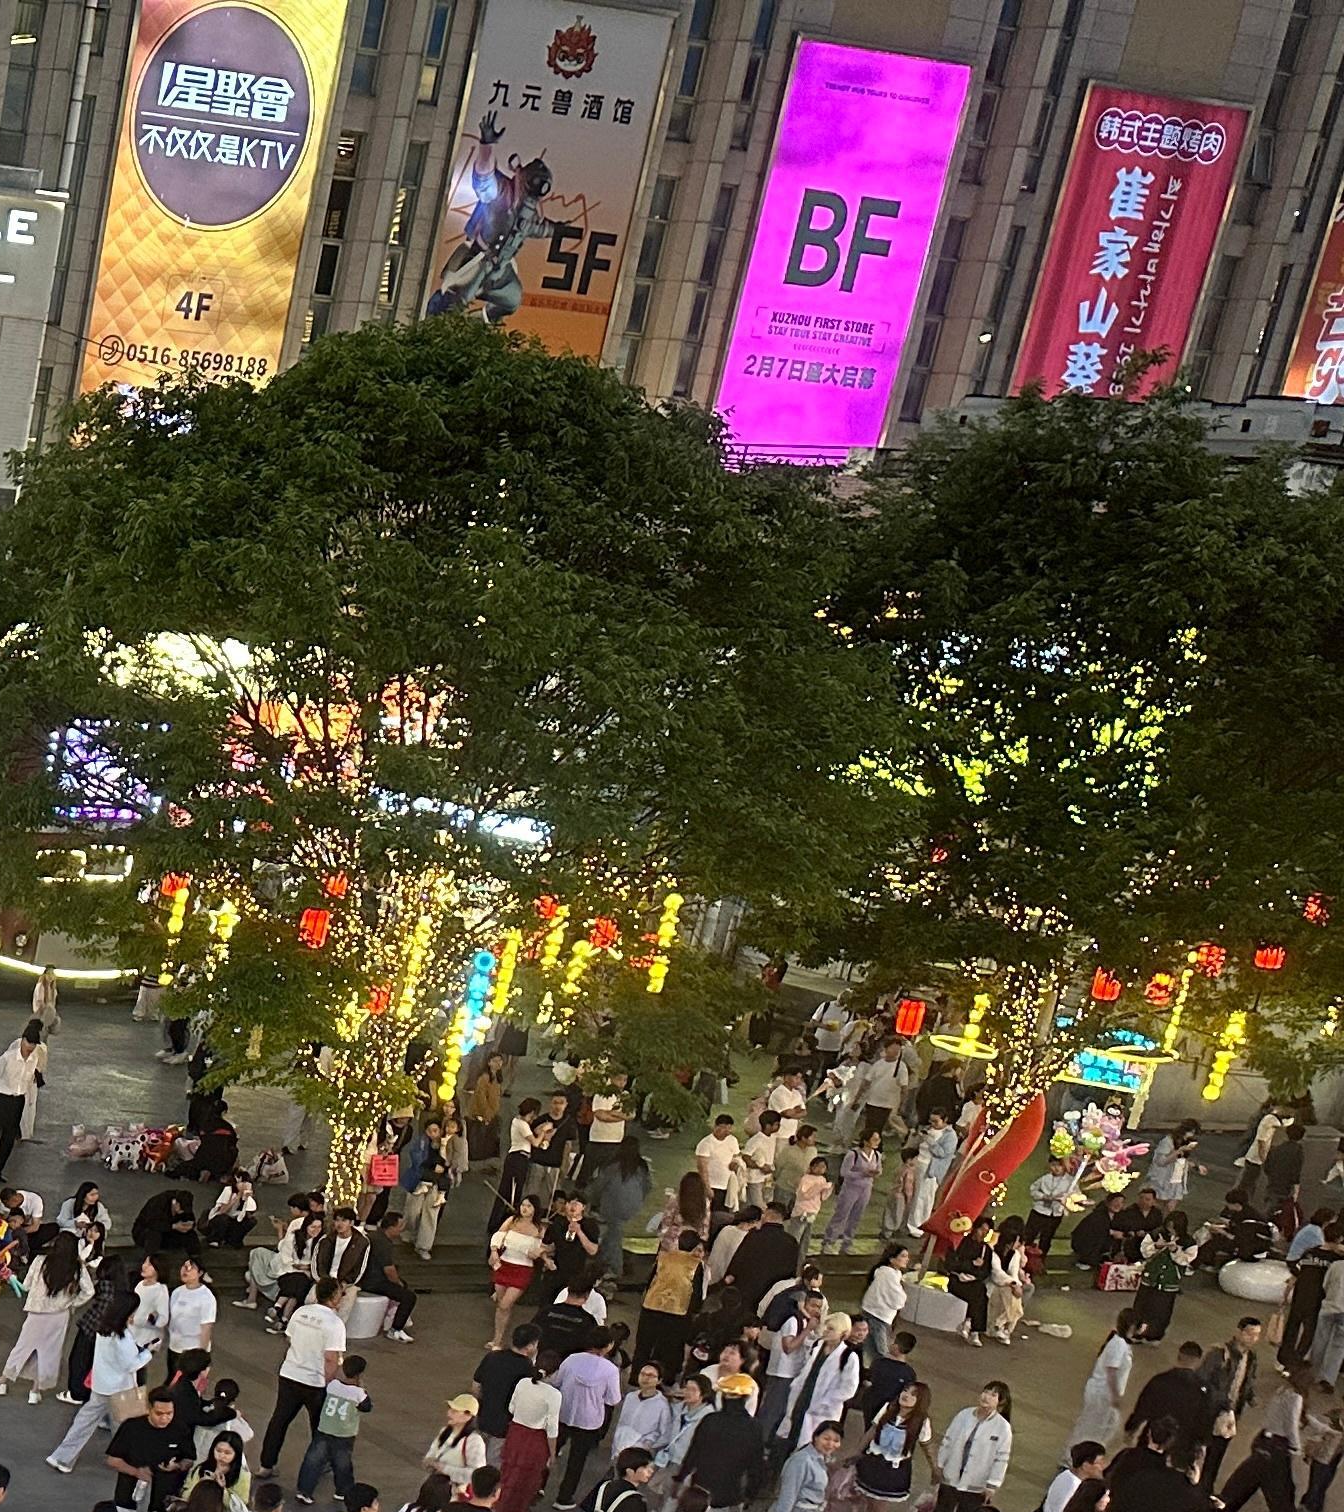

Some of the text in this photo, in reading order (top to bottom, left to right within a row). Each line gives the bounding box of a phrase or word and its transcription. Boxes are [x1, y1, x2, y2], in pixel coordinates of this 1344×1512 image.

[489, 79, 635, 126] 九元兽酒馆
[139, 124, 296, 171] 不仅仅是KTV
[1099, 113, 1223, 160] 韩式主题烤肉
[783, 188, 901, 293] BF
[1061, 166, 1155, 394] 崔家山葵
[176, 291, 214, 322] 4F
[771, 311, 811, 327] XUZHOU
[126, 342, 268, 376] 0516-85698188
[743, 354, 878, 390] 2月7日盛大启幕
[325, 1397, 350, 1420] 84
